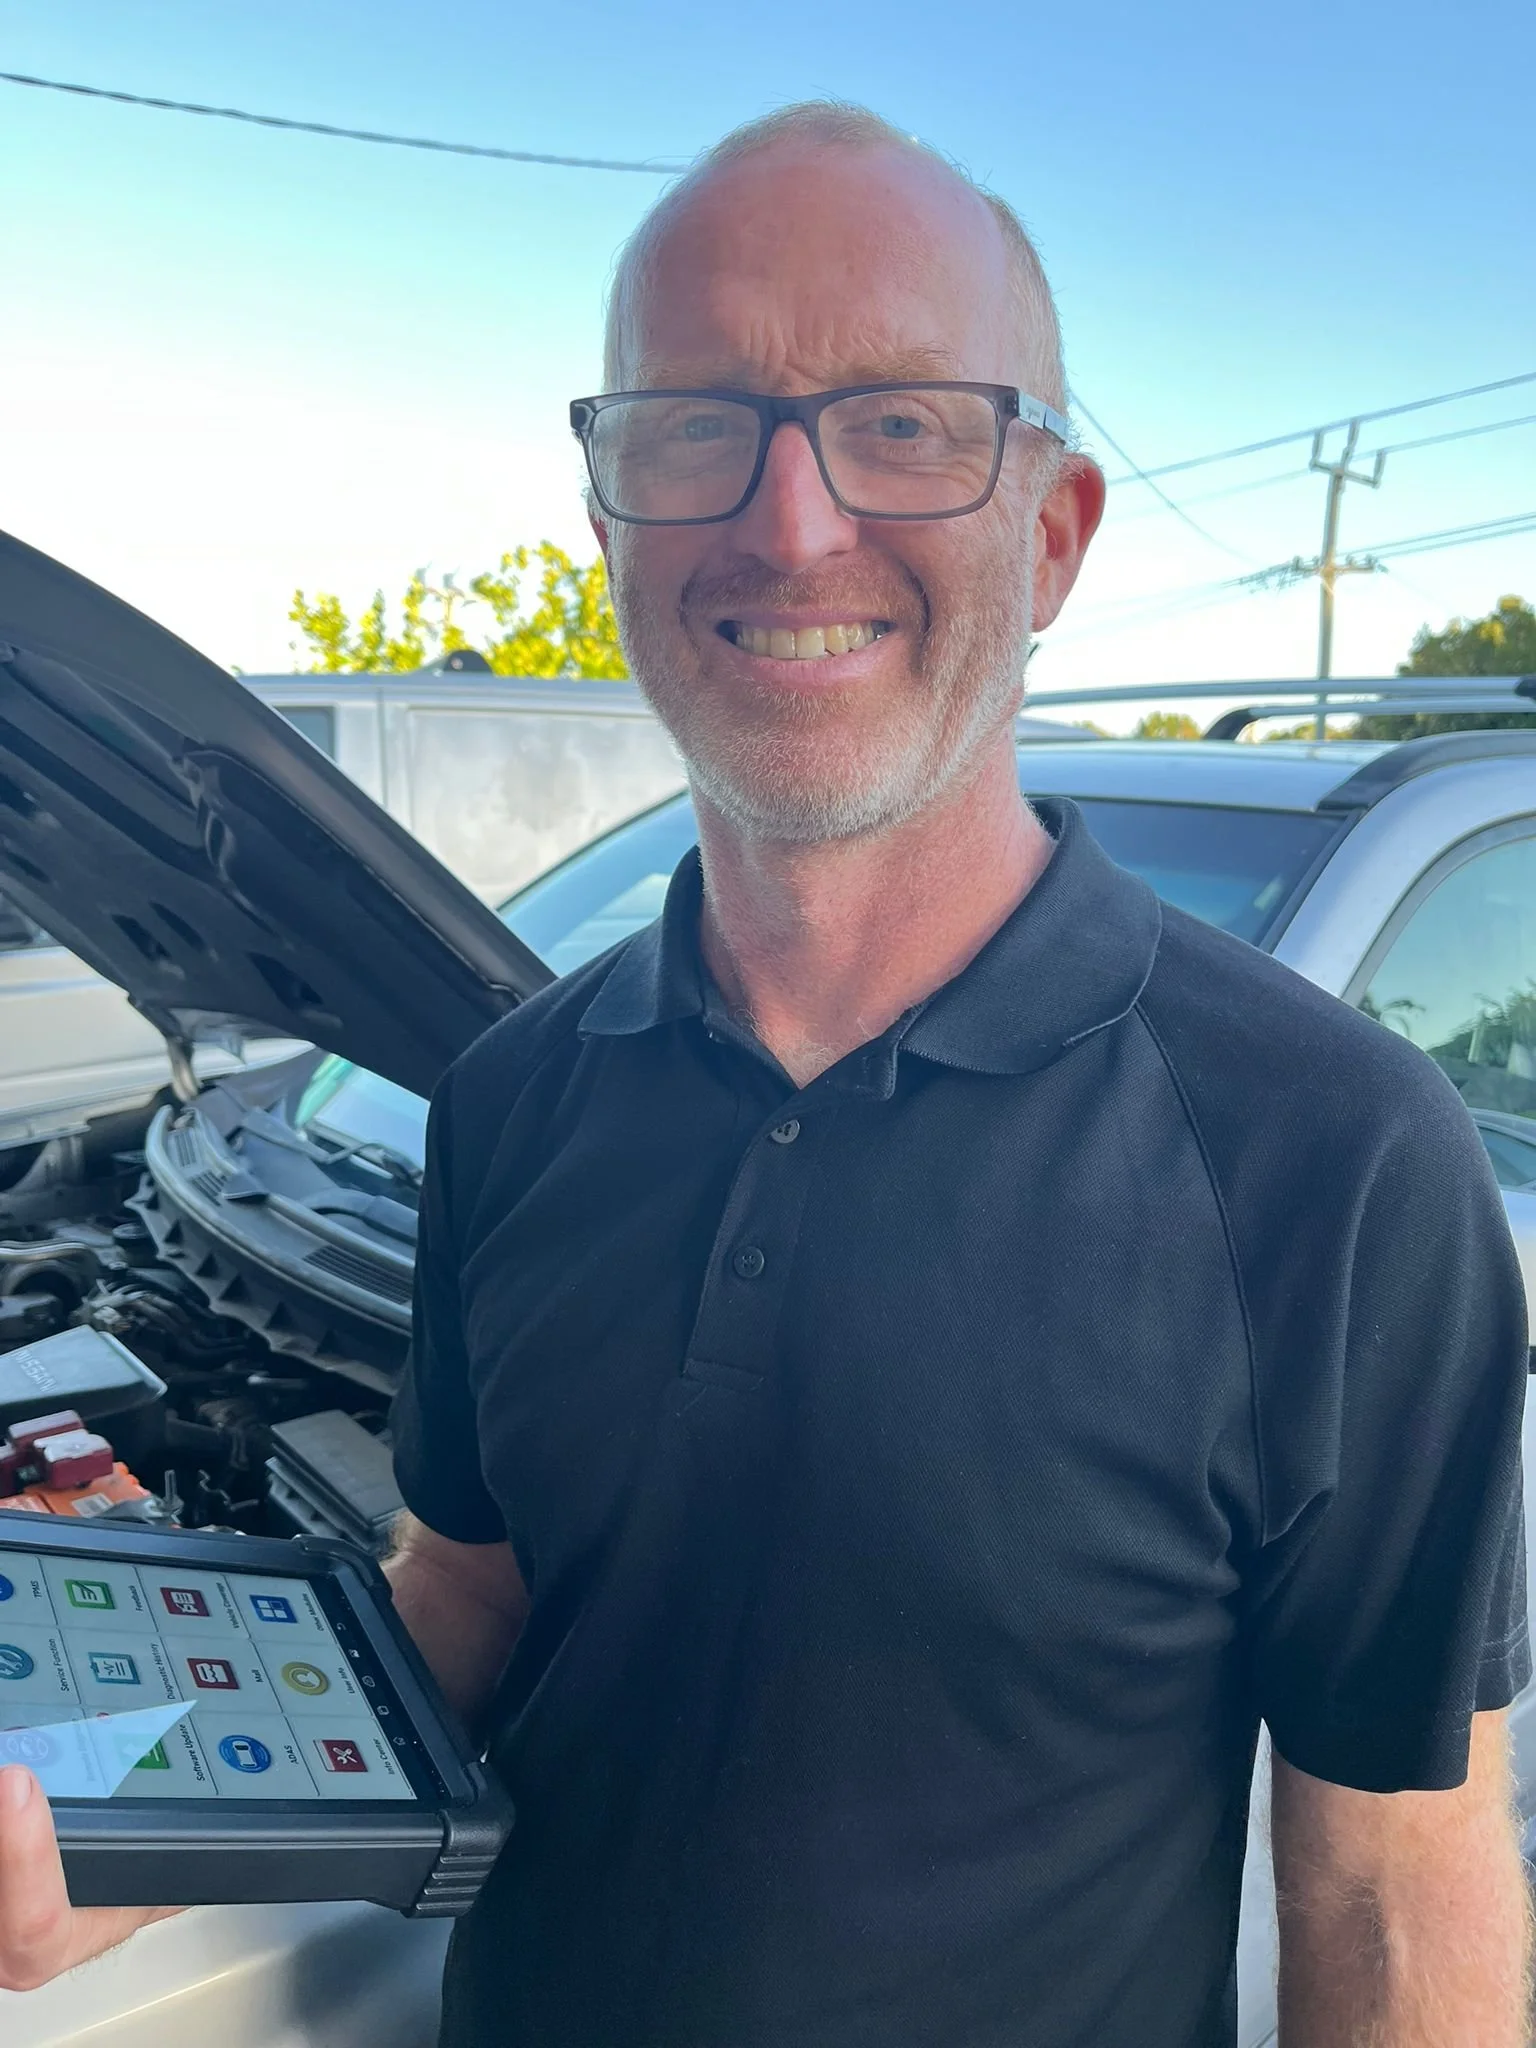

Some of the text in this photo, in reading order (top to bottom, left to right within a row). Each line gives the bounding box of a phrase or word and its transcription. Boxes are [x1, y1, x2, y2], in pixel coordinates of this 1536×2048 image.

[30, 1580, 42, 1598] TPMS
[128, 1585, 143, 1611] Feedback
[49, 1638, 70, 1692] Service Function
[151, 1643, 175, 1700] Diagnostic History
[252, 1669, 263, 1683] Mall
[179, 1724, 205, 1781] Software Update
[284, 1745, 299, 1765] ADAS
[384, 1760, 395, 1775] Info
